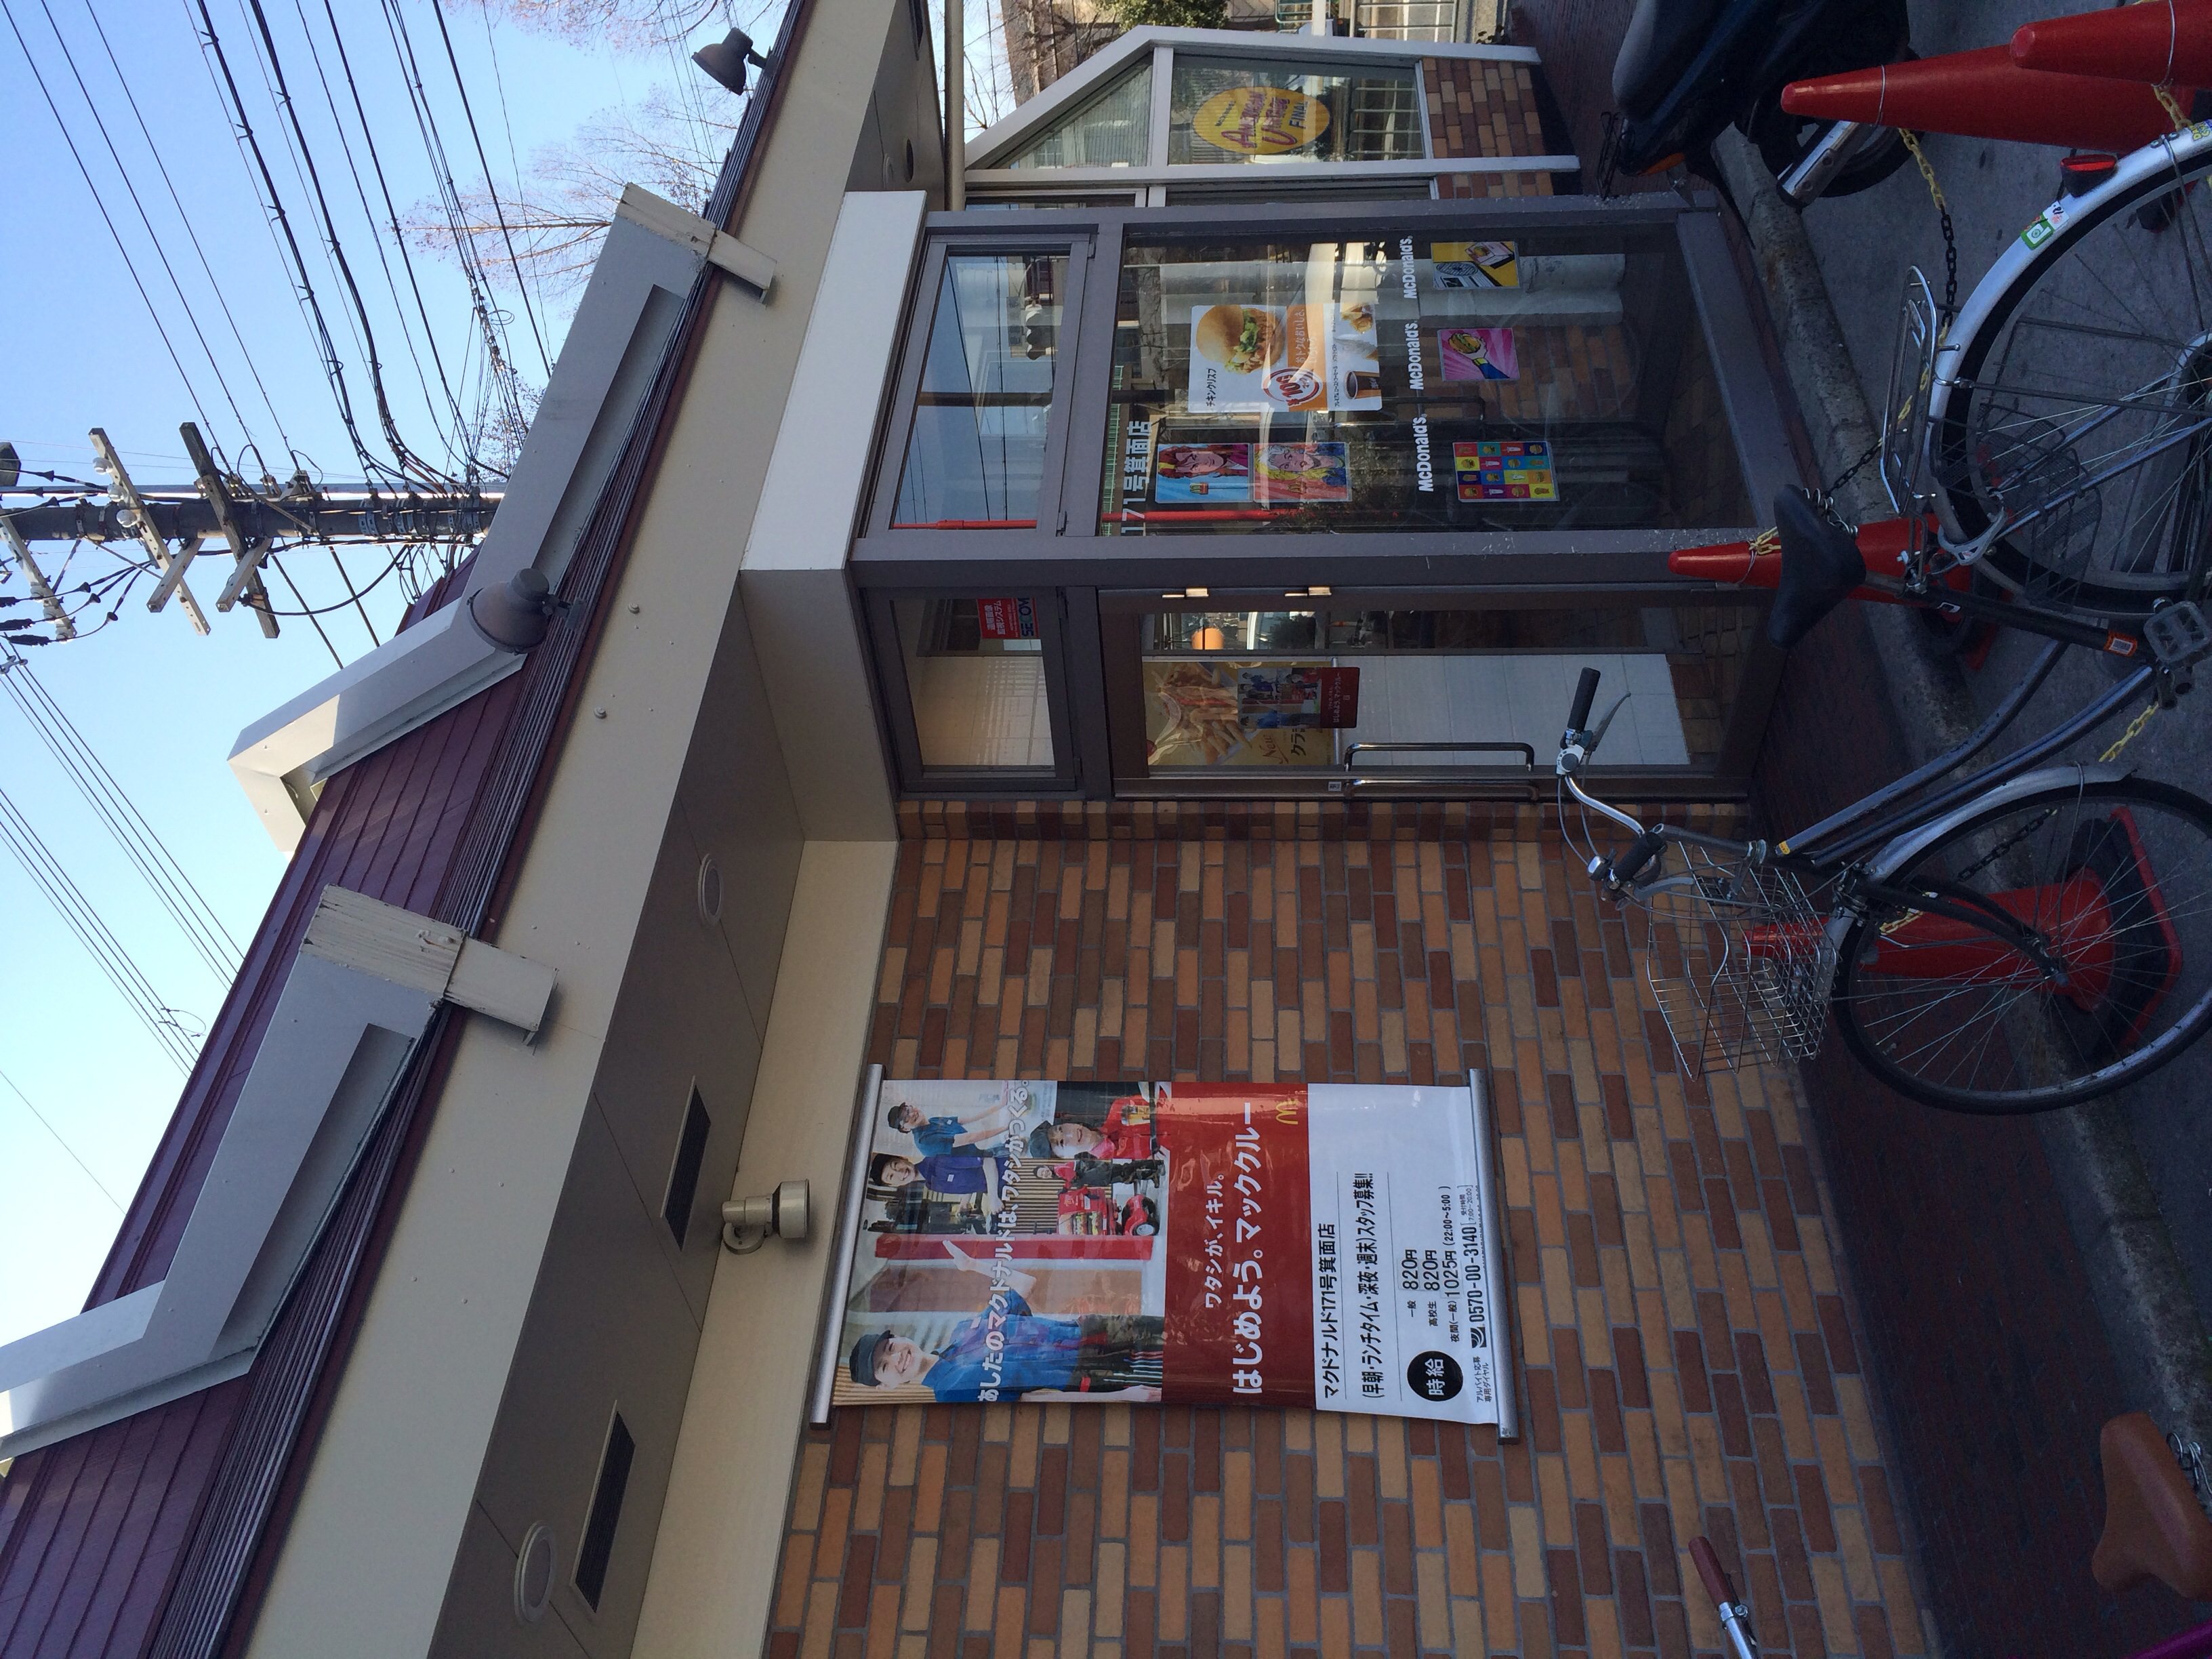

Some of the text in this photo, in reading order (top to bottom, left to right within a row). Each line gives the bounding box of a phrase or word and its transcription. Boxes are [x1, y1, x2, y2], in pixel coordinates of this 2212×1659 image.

[1288, 101, 1308, 129] FINAL
[1399, 238, 1418, 299] McDonald's
[1206, 368, 1217, 407] チキンクリスプ
[1404, 322, 1425, 390] McDonald's
[1121, 420, 1153, 534] 171号箕面店
[1412, 416, 1435, 492] McDonald's
[1018, 597, 1034, 636] SECOM
[977, 1080, 1029, 1401] あしたのマクドナルドは、ワタシがつくる。
[1204, 1172, 1225, 1308] ワタシが、イキル。
[1232, 1102, 1263, 1393] はじめよう。マッククルー
[1441, 1250, 1460, 1297] 1025円
[1401, 1249, 1419, 1317] 一般 820円
[1422, 1250, 1440, 1326] 高校生 820円
[1461, 1227, 1485, 1322] 0570-00-3140
[1317, 1223, 1340, 1398] マクドナルド171号箕面店
[1425, 1358, 1446, 1396] 時給
[1473, 1357, 1484, 1402] アルバイト応募
[1481, 1363, 1492, 1402] 専用ダイヤル
